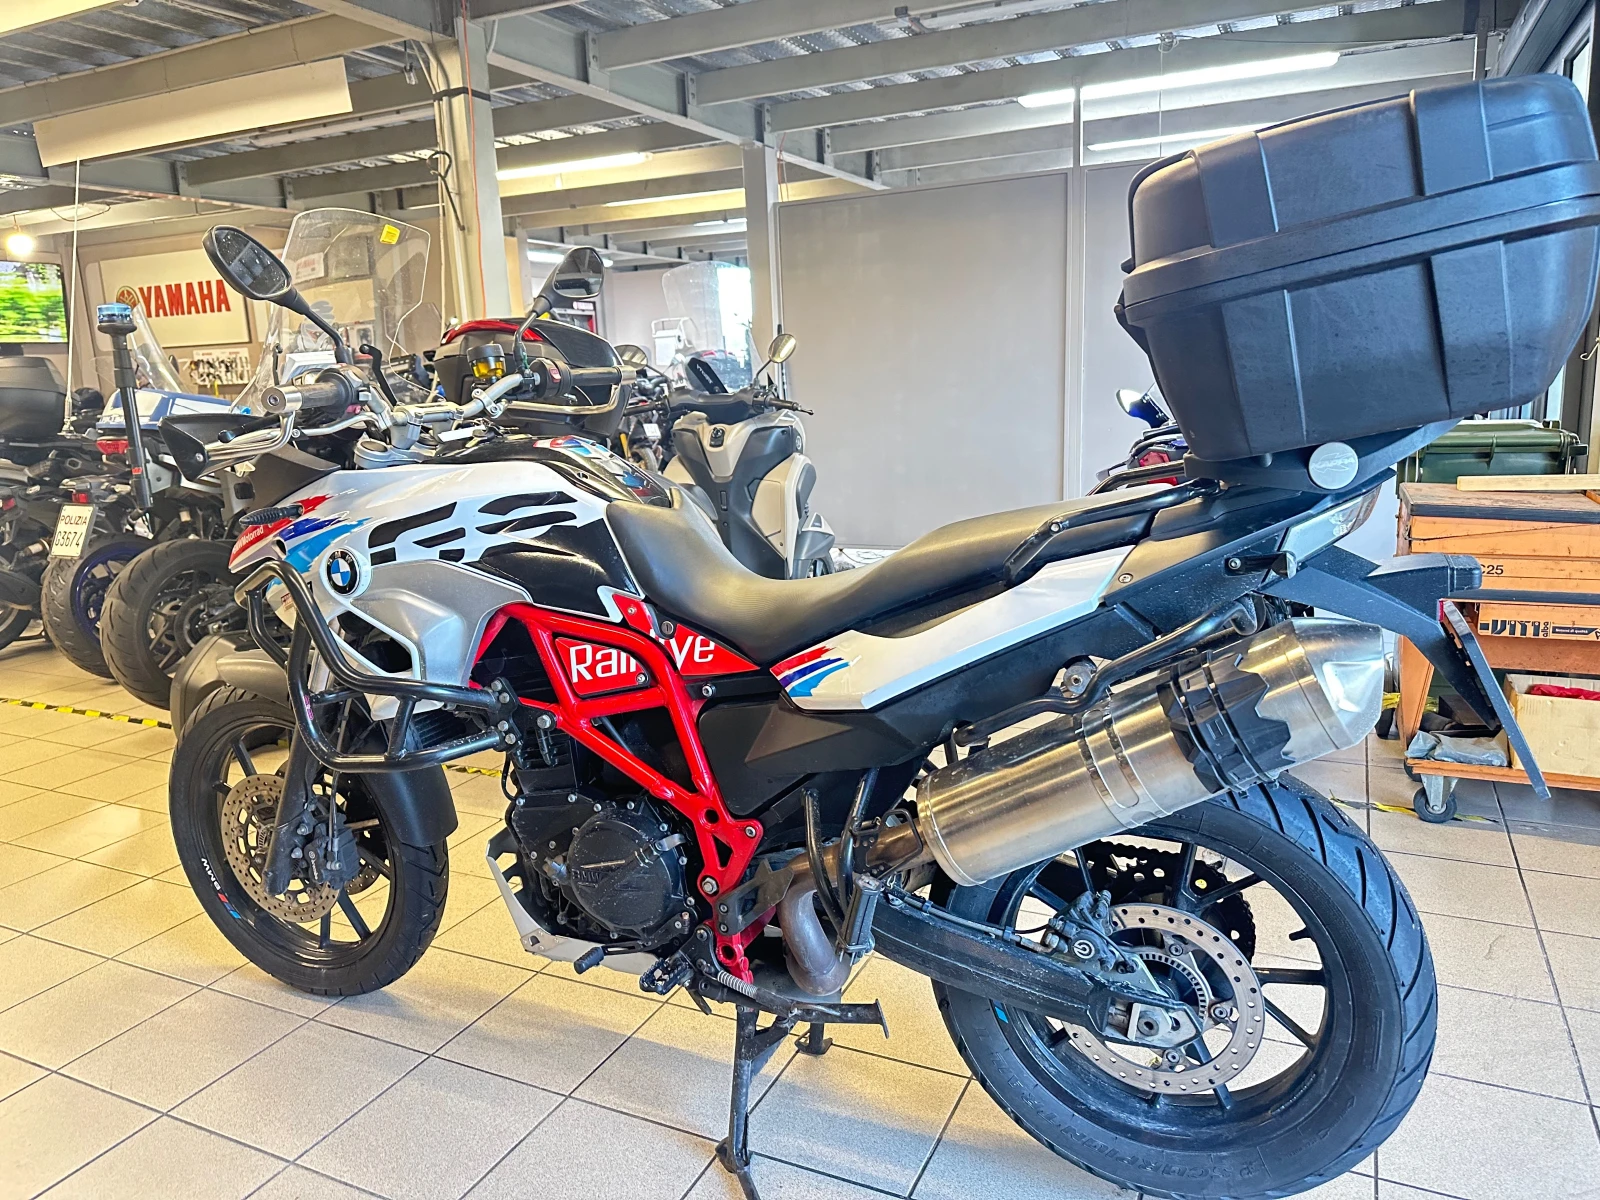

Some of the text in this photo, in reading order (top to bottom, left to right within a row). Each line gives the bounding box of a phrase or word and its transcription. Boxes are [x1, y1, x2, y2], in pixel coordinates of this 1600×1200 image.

[138, 279, 231, 318] YAMAHA
[60, 515, 87, 525] POLIZIA
[201, 857, 221, 891] BMW
